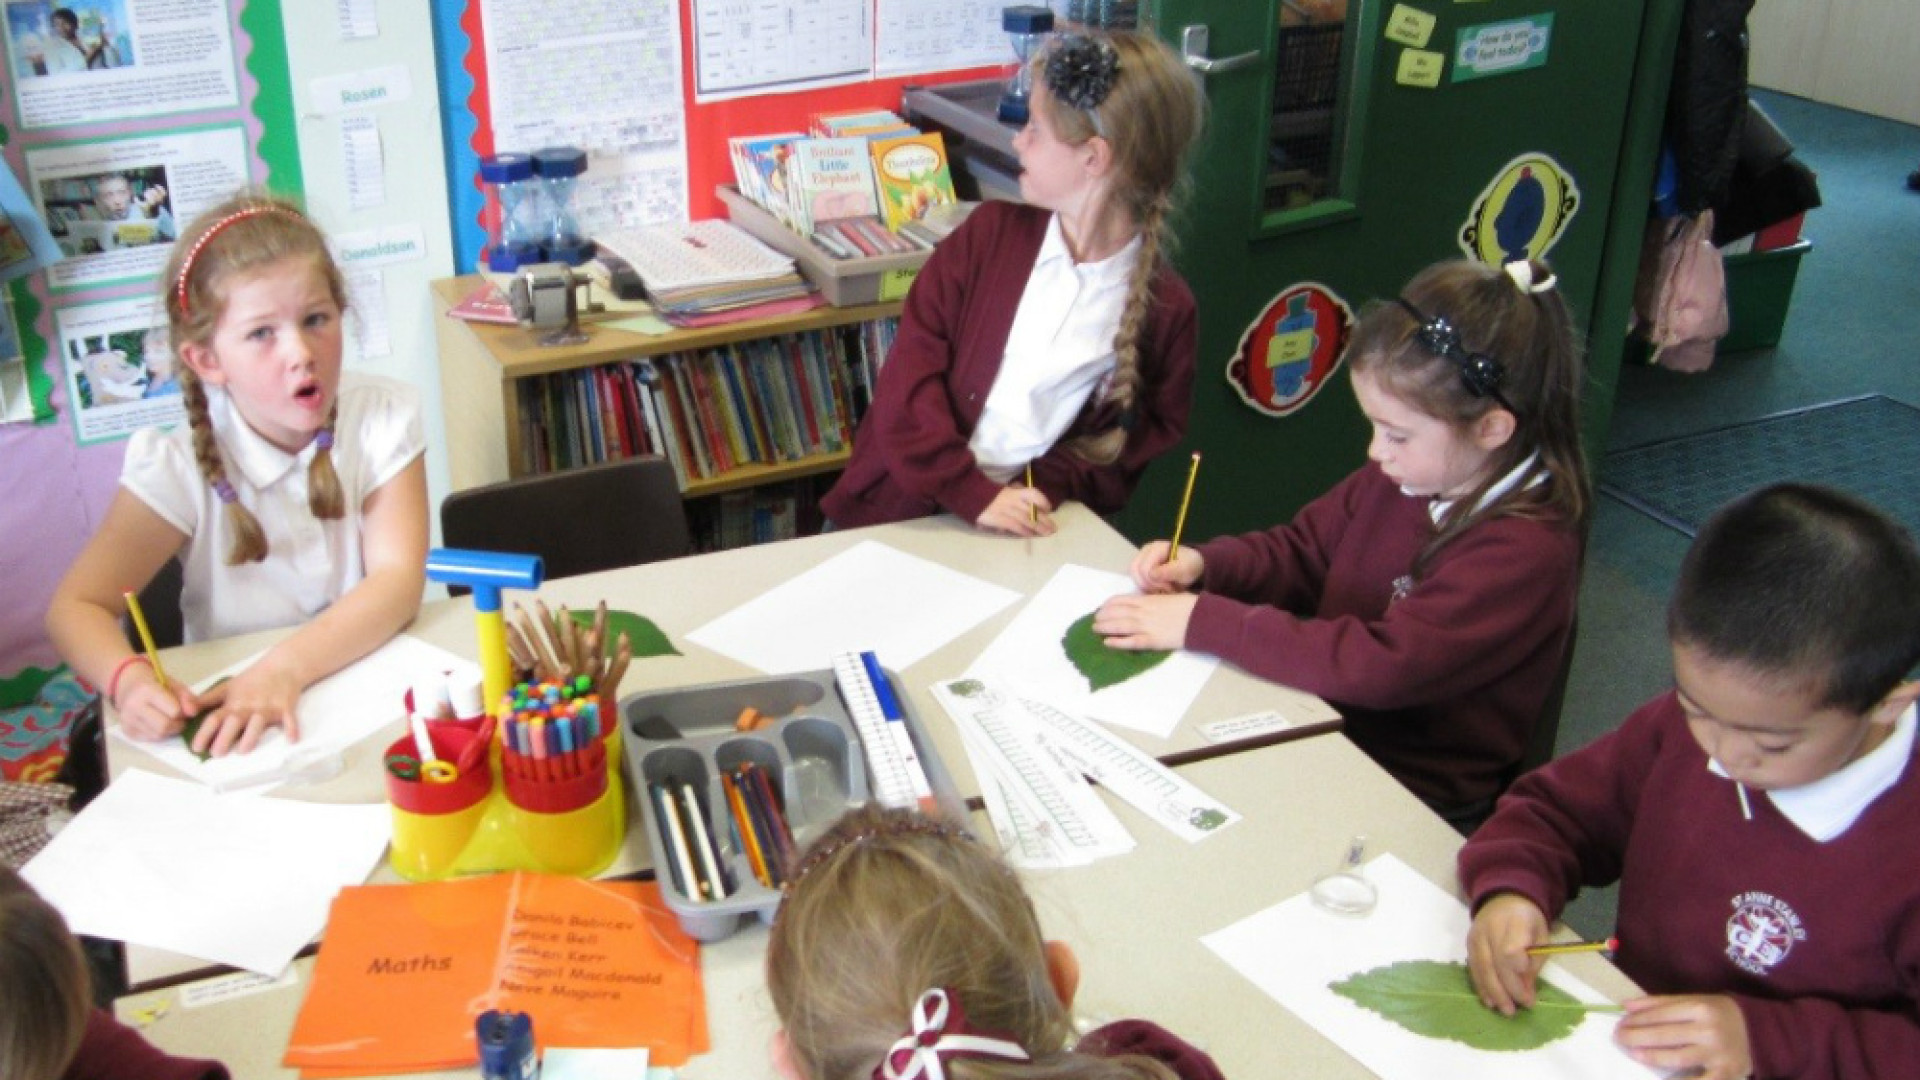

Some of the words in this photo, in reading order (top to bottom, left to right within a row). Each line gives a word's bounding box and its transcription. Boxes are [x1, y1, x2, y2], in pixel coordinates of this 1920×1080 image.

[341, 86, 387, 104] Rosen
[819, 158, 849, 172] Little
[566, 931, 598, 944] Bell
[567, 950, 607, 962] Kerr
[365, 954, 453, 976] Maths
